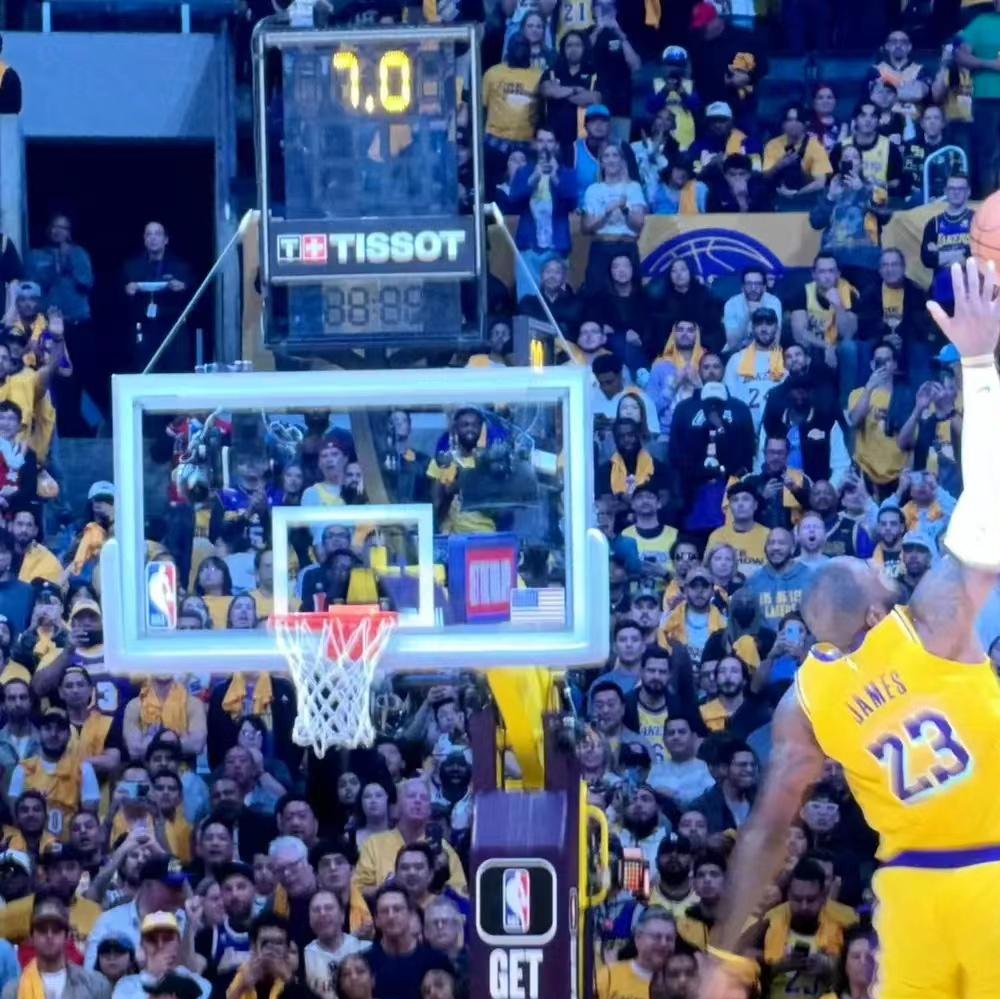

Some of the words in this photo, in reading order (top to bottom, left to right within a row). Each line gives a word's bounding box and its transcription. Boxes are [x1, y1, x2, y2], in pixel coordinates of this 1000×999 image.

[332, 50, 411, 114] 7.0
[329, 230, 466, 264] TISSOT
[847, 672, 907, 725] JAMES
[866, 706, 973, 804] 23
[489, 948, 544, 999] GET
